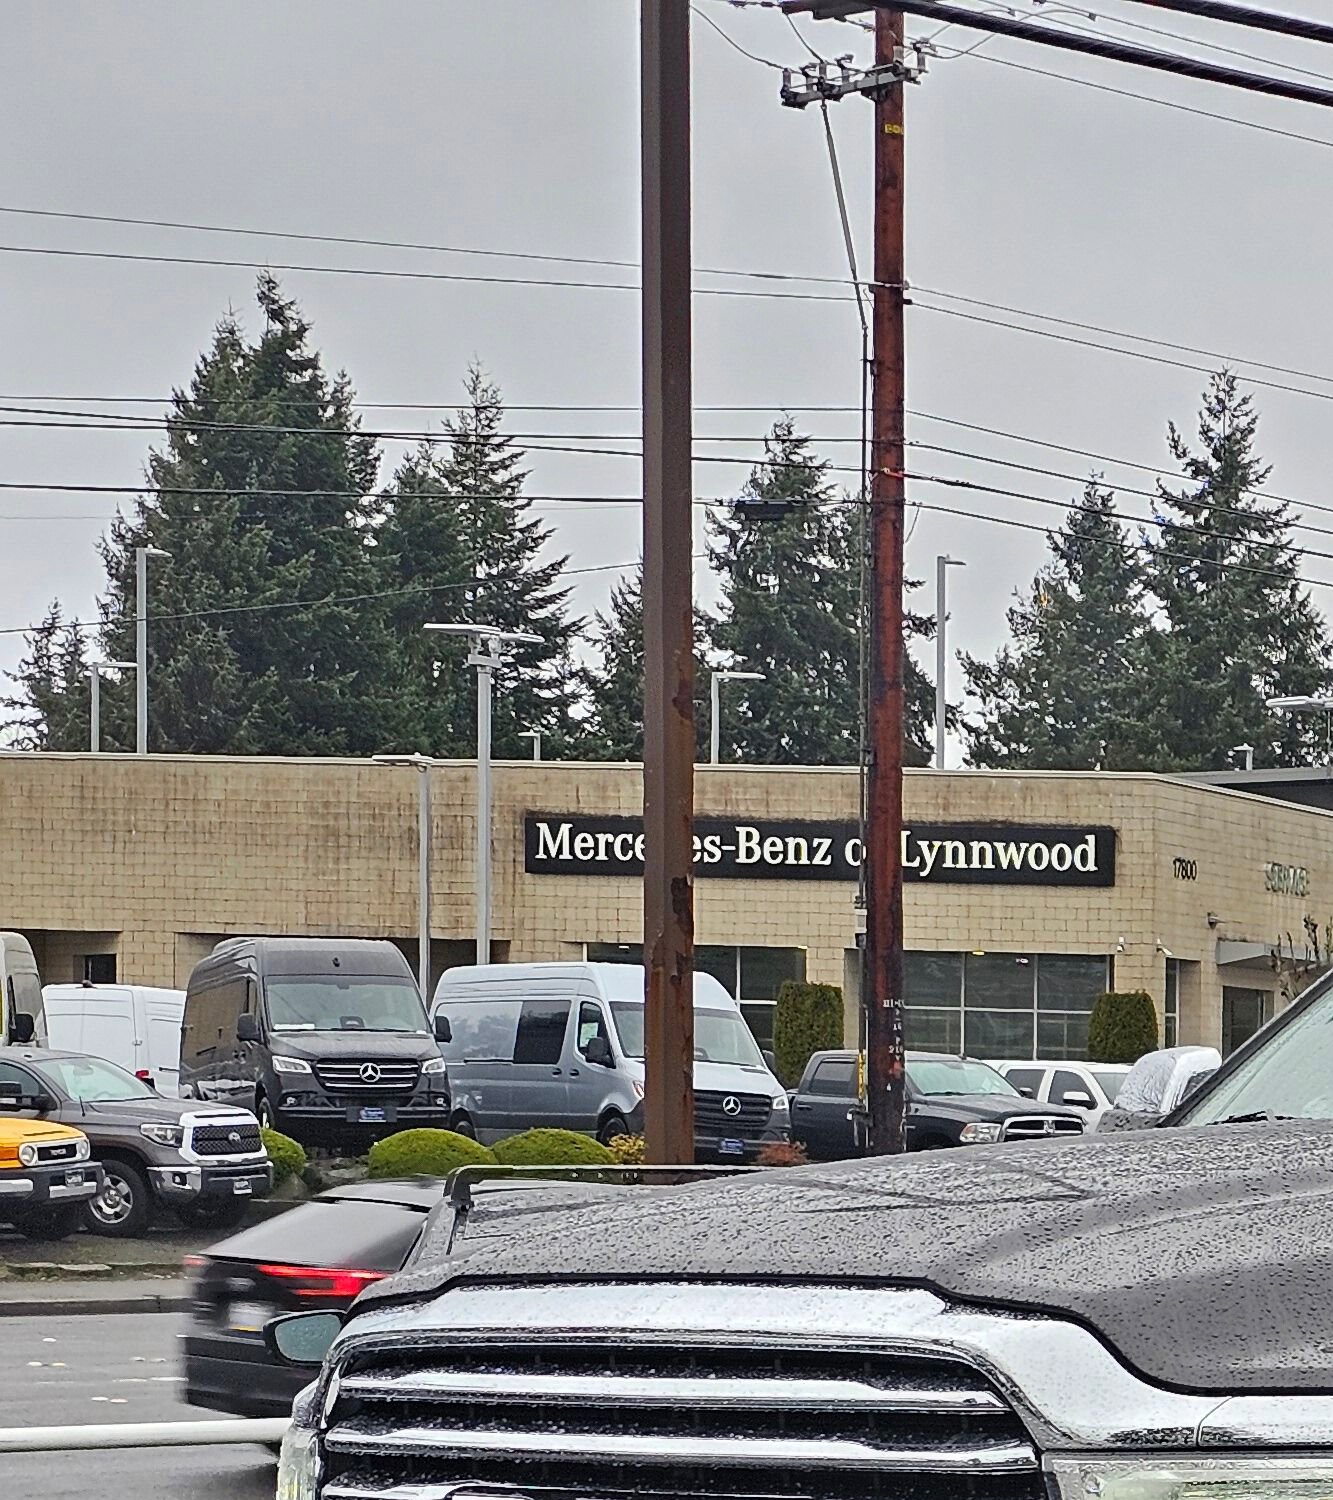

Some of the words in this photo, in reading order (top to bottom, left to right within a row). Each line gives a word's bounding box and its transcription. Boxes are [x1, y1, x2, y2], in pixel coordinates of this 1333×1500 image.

[535, 822, 832, 865] Merces-Benz
[845, 838, 867, 867] o
[901, 830, 1098, 877] Lynnwood
[1173, 856, 1197, 880] 17800
